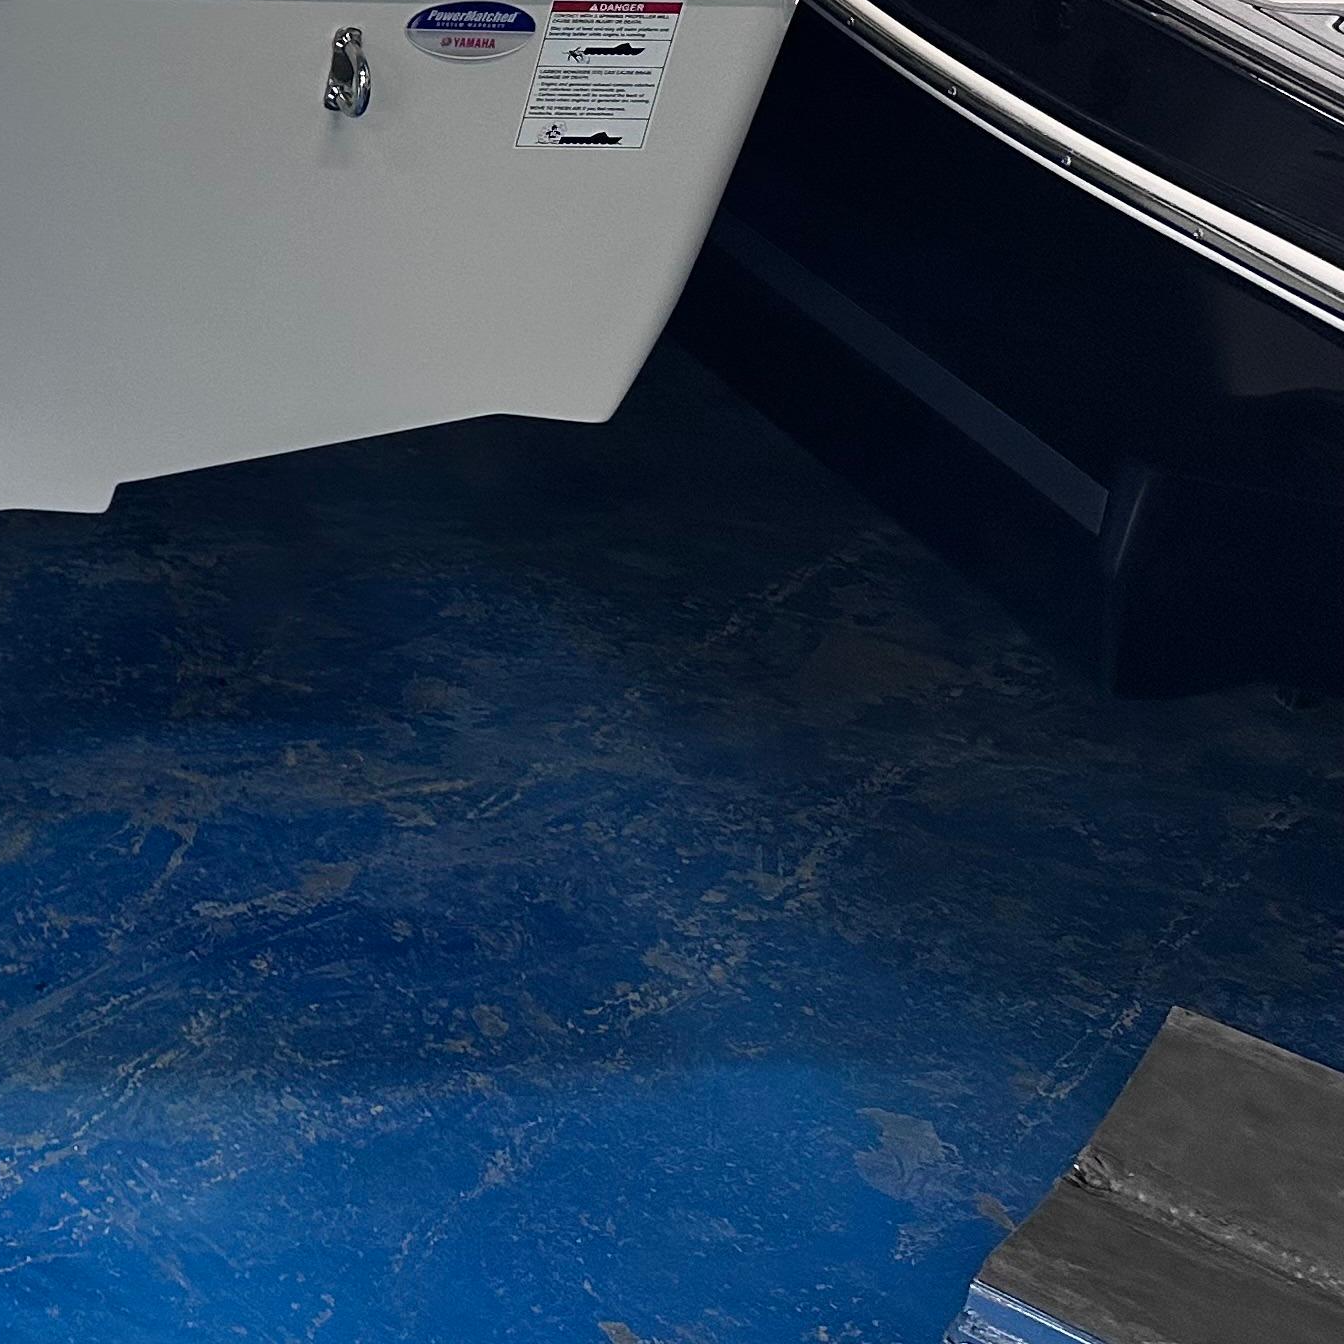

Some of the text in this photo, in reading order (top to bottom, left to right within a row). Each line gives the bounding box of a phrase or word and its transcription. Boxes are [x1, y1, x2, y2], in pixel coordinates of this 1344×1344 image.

[599, 3, 645, 12] DANGER
[427, 9, 518, 23] PowerMatched
[454, 36, 495, 49] YAMAHA
